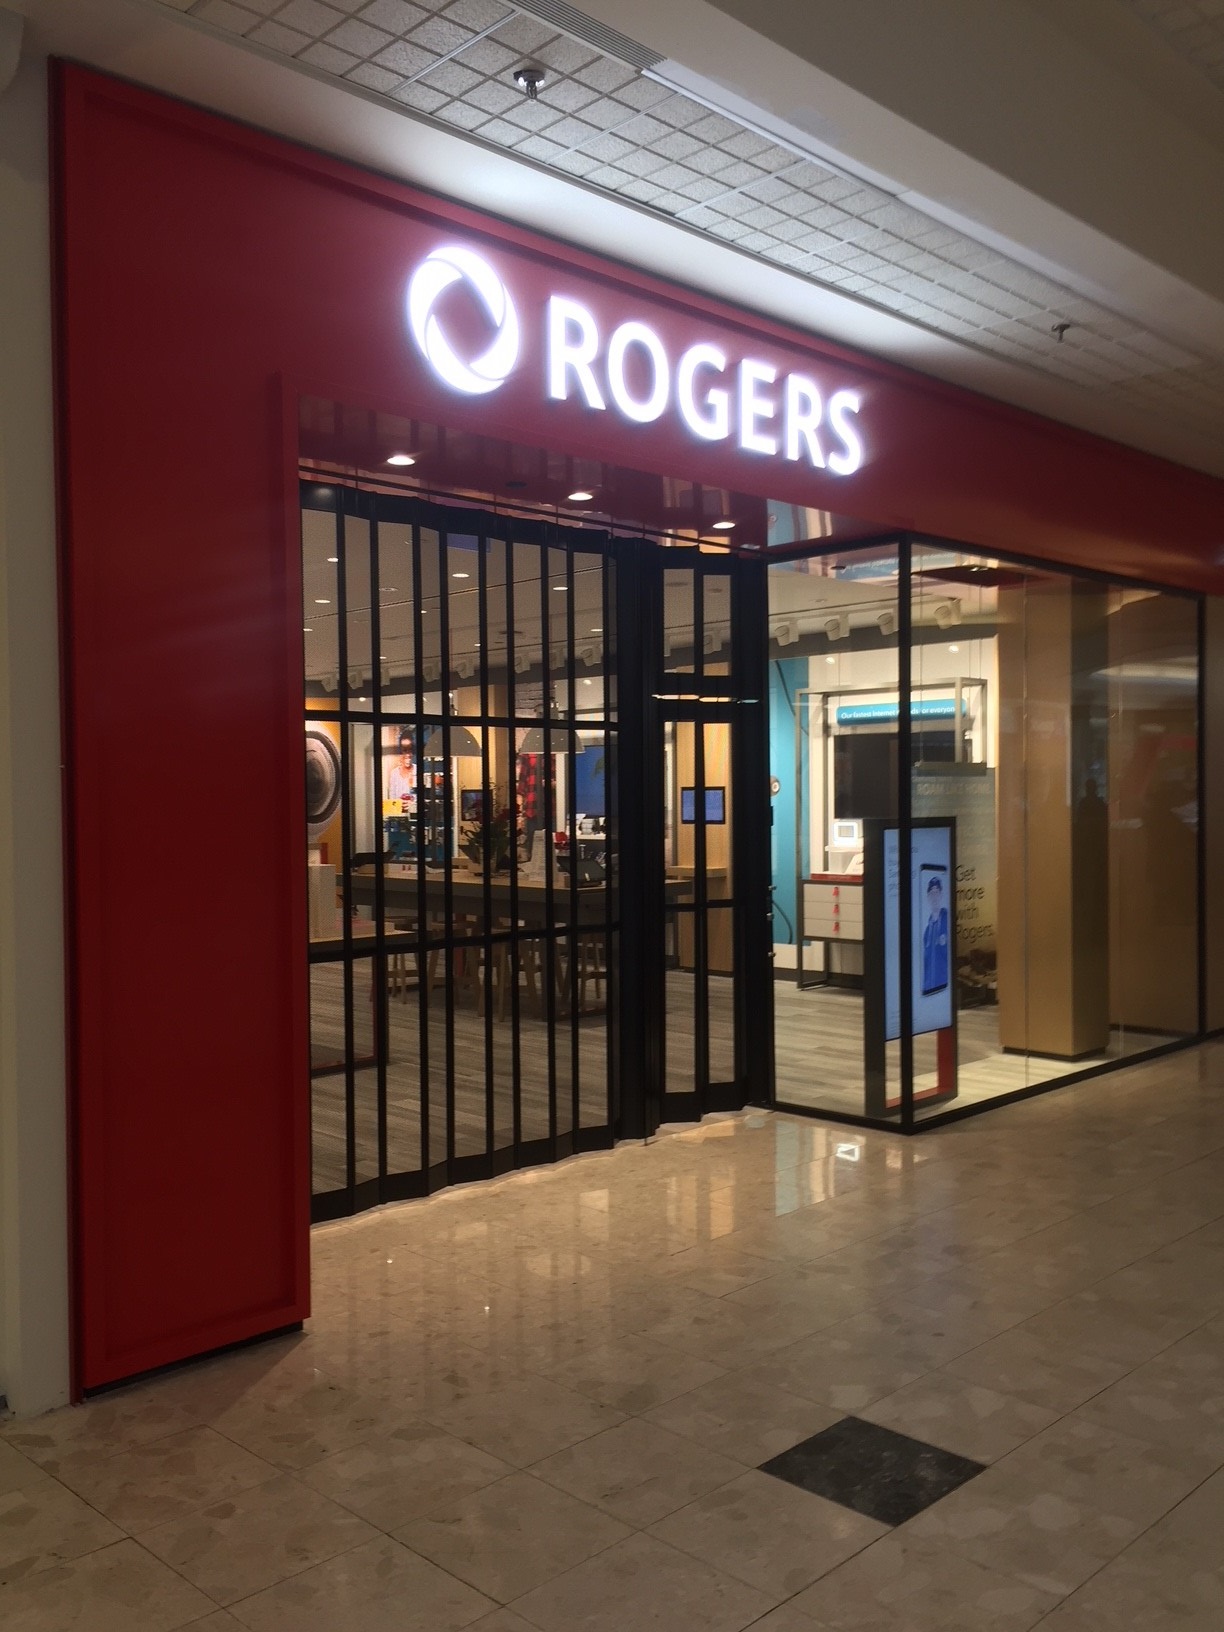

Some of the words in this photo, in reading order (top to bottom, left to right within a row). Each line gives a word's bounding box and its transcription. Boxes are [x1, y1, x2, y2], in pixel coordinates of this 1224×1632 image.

[549, 296, 863, 476] ROGERS
[930, 706, 955, 714] everyon
[954, 864, 976, 881] Get
